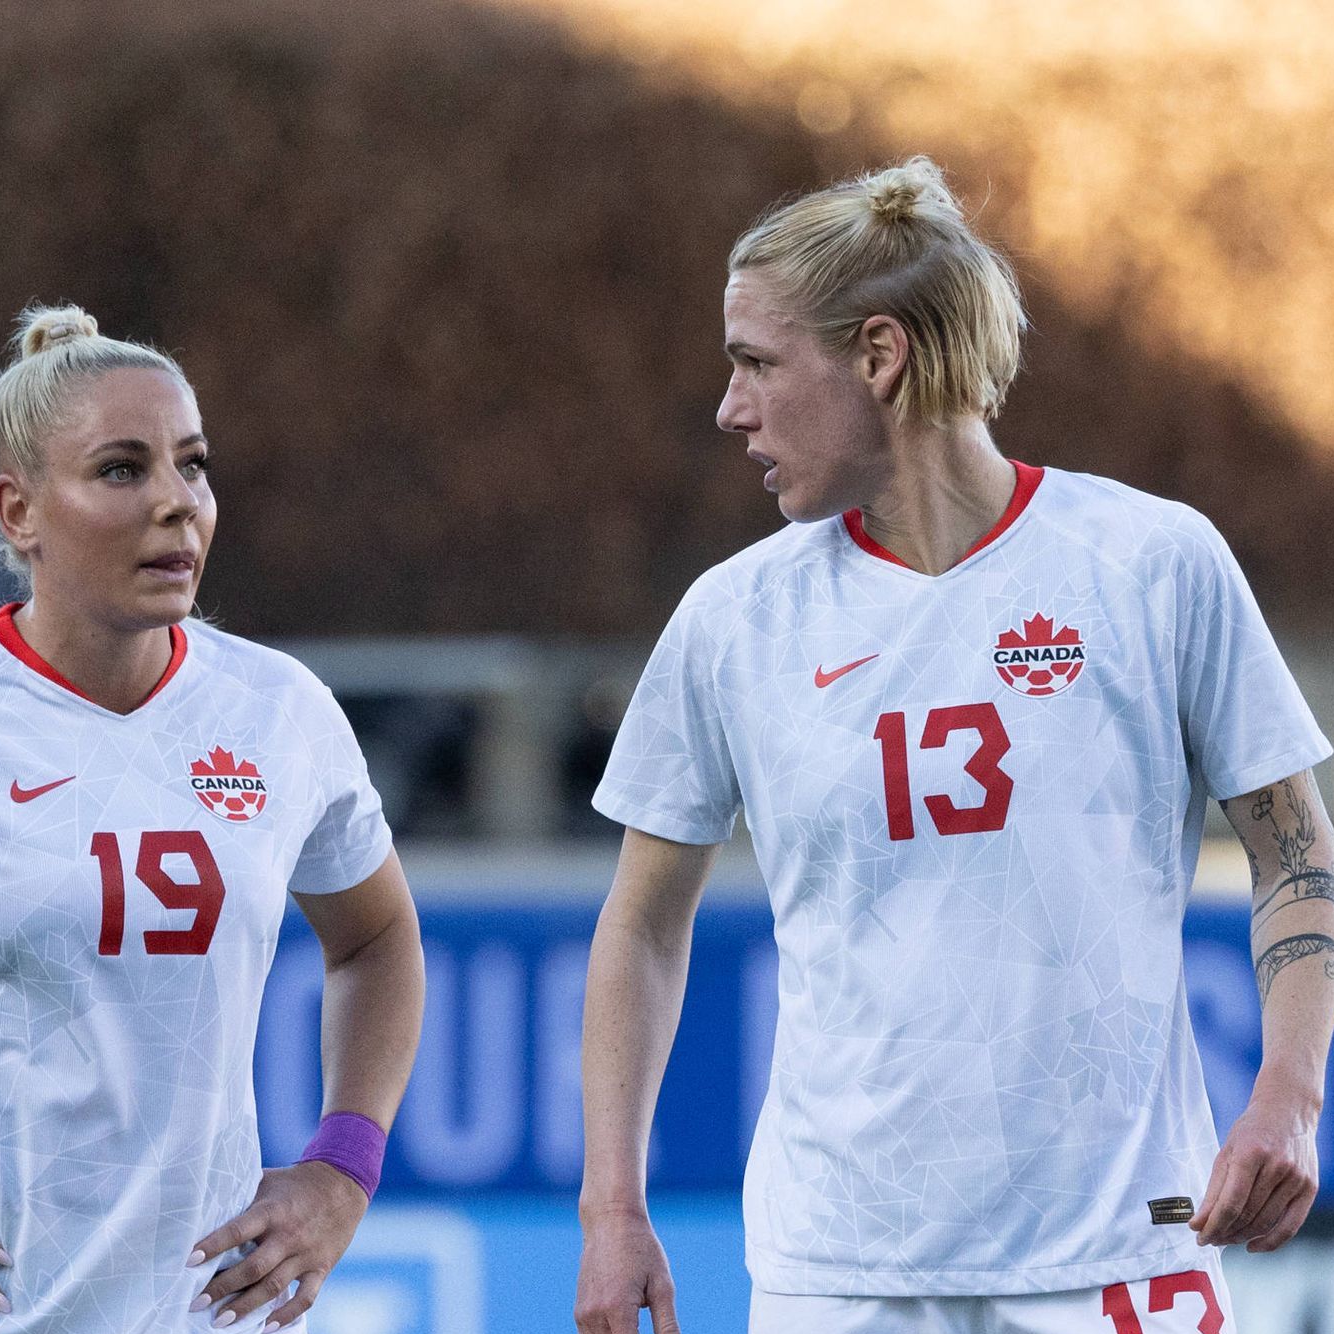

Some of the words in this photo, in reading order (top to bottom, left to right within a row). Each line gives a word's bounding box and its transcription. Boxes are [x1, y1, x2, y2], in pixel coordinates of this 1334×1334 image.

[993, 646, 1085, 664] CANADA
[191, 777, 267, 793] CANADA
[873, 702, 1014, 841] 13
[90, 830, 226, 956] 19
